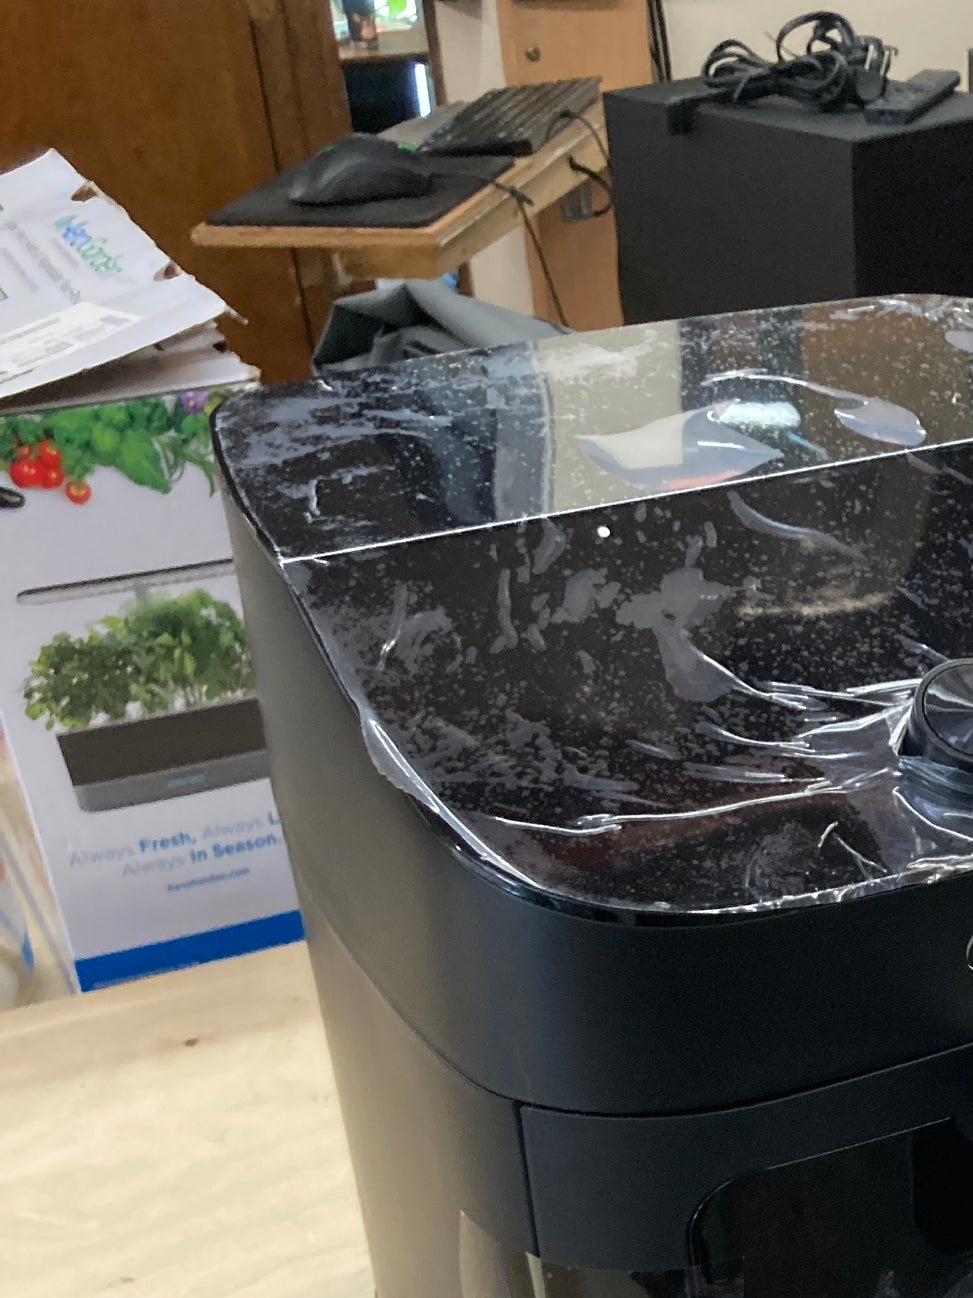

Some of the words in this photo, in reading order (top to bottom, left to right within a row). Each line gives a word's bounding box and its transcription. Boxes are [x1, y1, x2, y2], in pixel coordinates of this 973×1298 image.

[70, 846, 135, 867] Always
[139, 831, 197, 853] Fresh,
[203, 818, 263, 840] Always
[122, 853, 185, 877] Always
[190, 850, 208, 863] In
